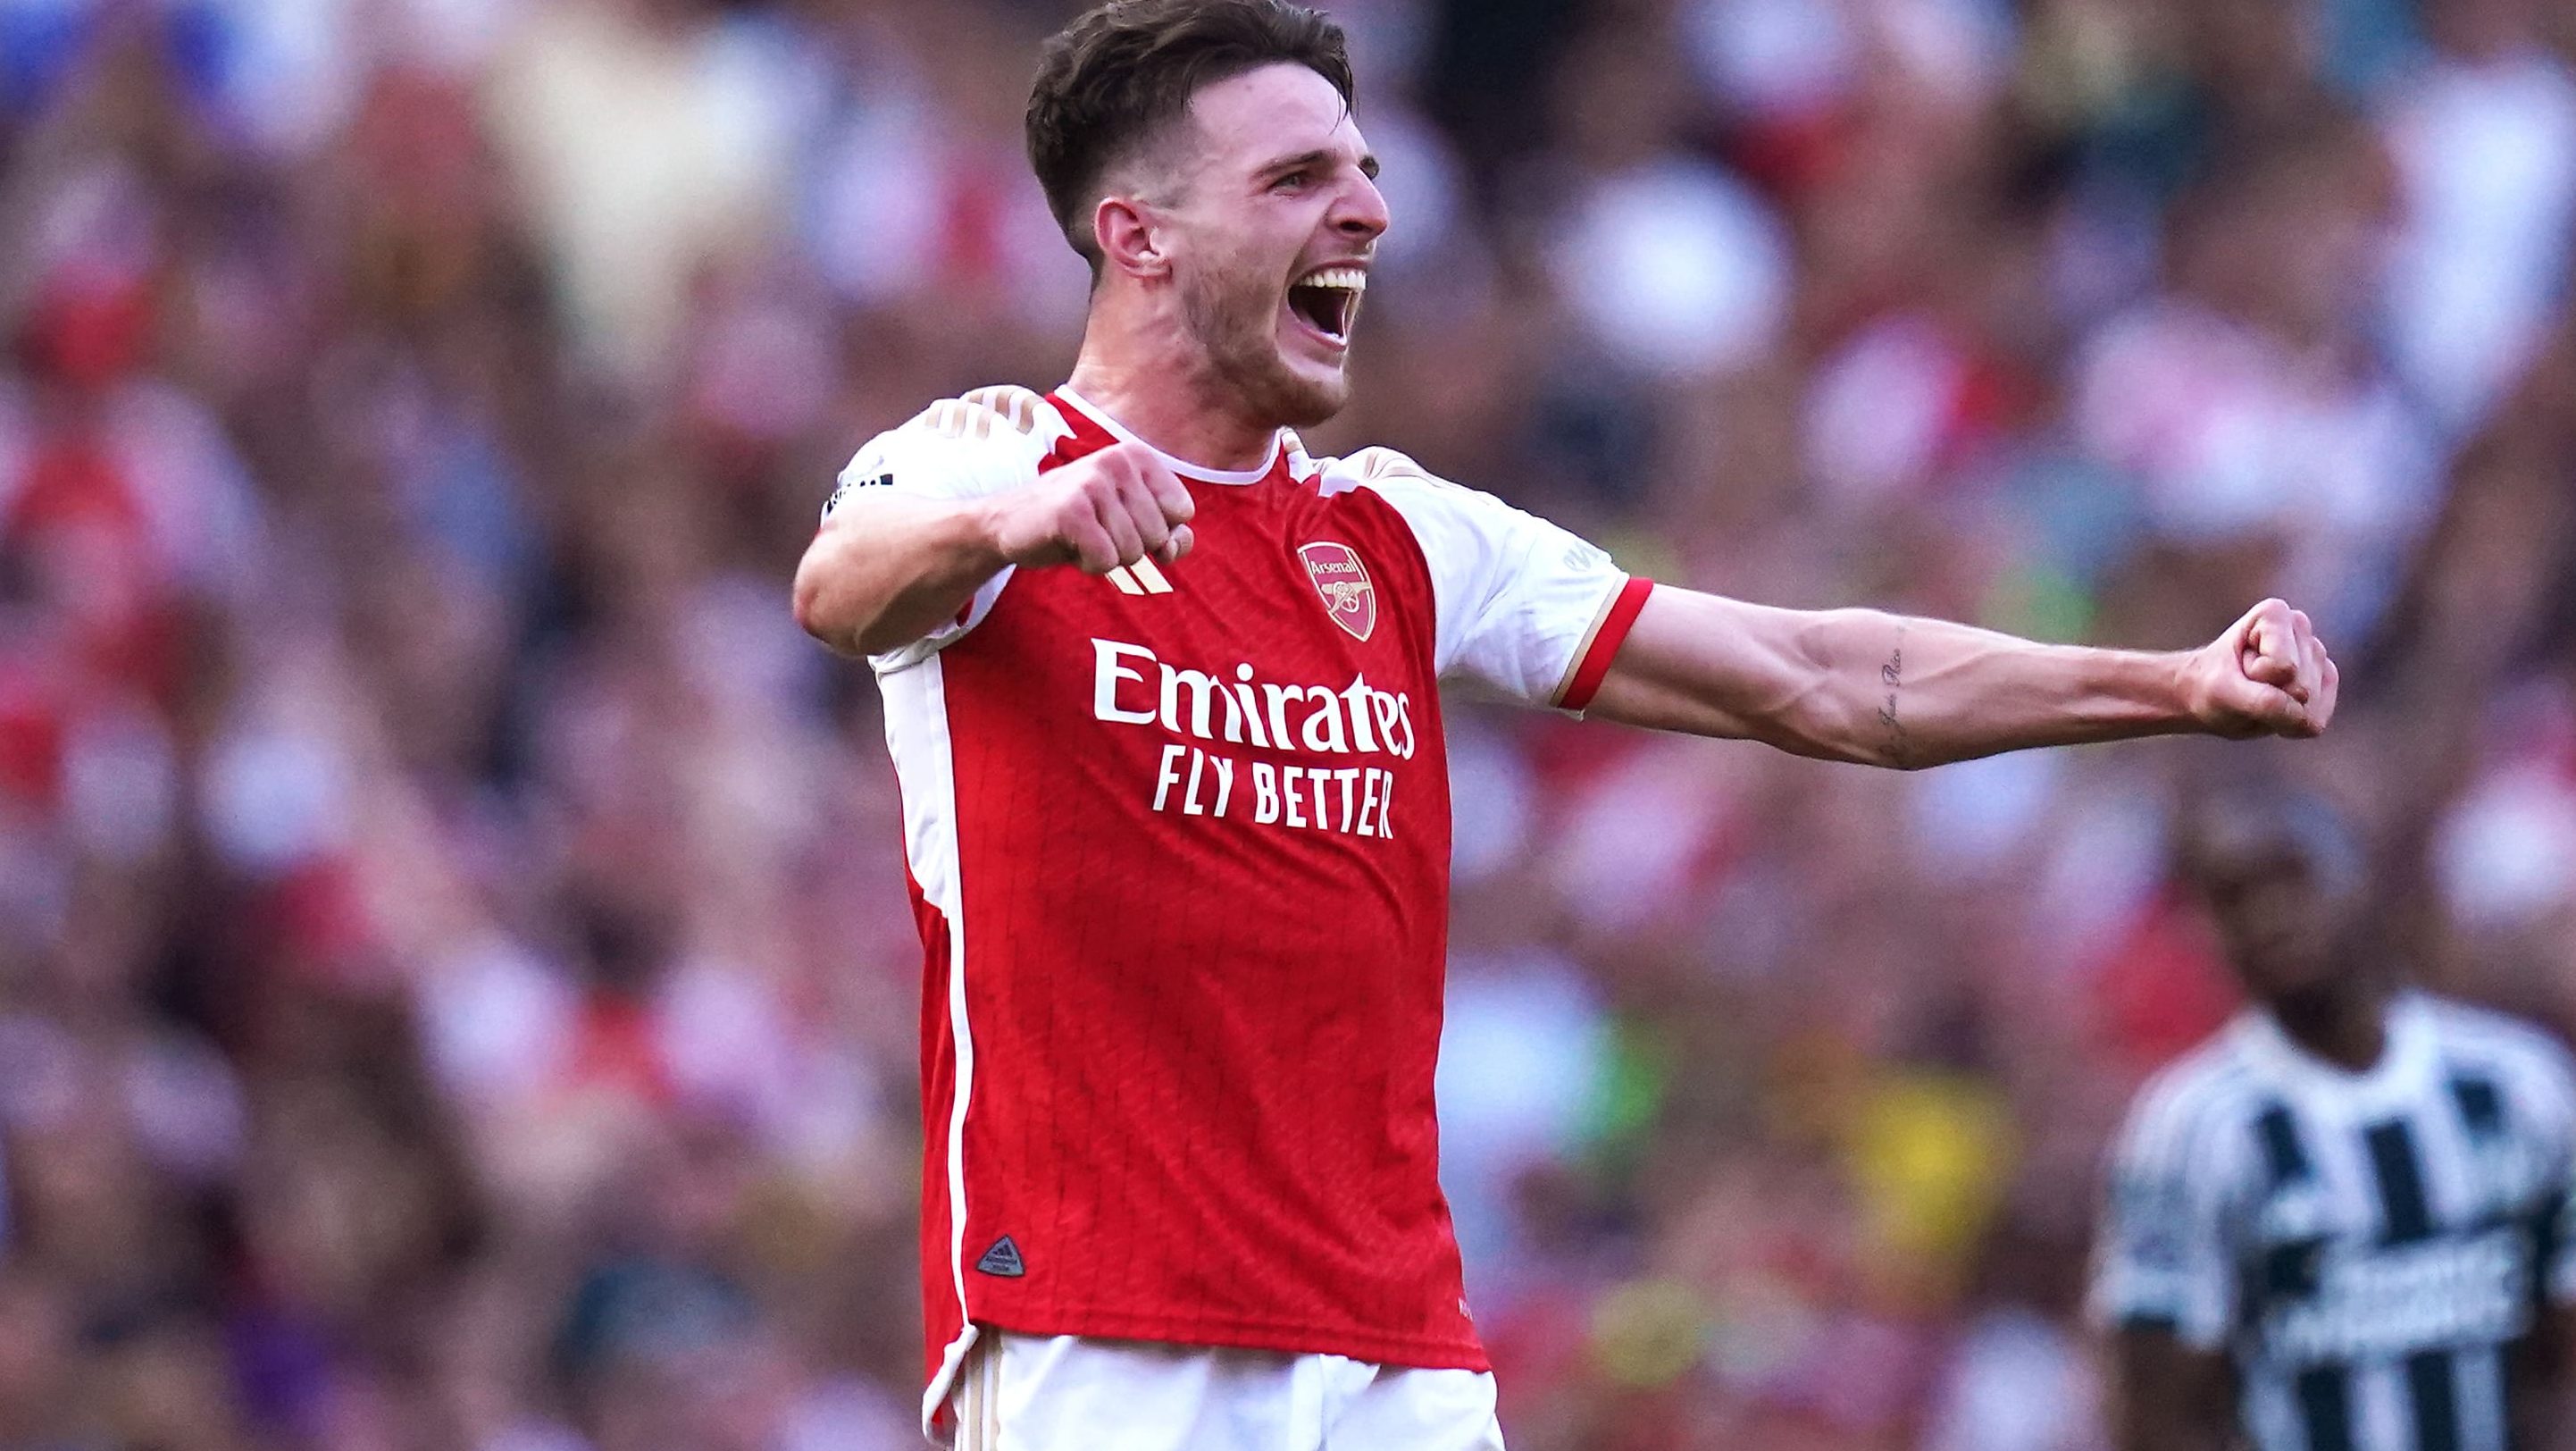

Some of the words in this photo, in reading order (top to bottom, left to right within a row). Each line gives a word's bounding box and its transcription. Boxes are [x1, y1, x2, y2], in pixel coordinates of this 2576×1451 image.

[1310, 558, 1356, 575] Arsenal
[1091, 638, 1415, 760] Emirates
[1152, 744, 1234, 818] FLY
[1252, 762, 1393, 839] BETTER
